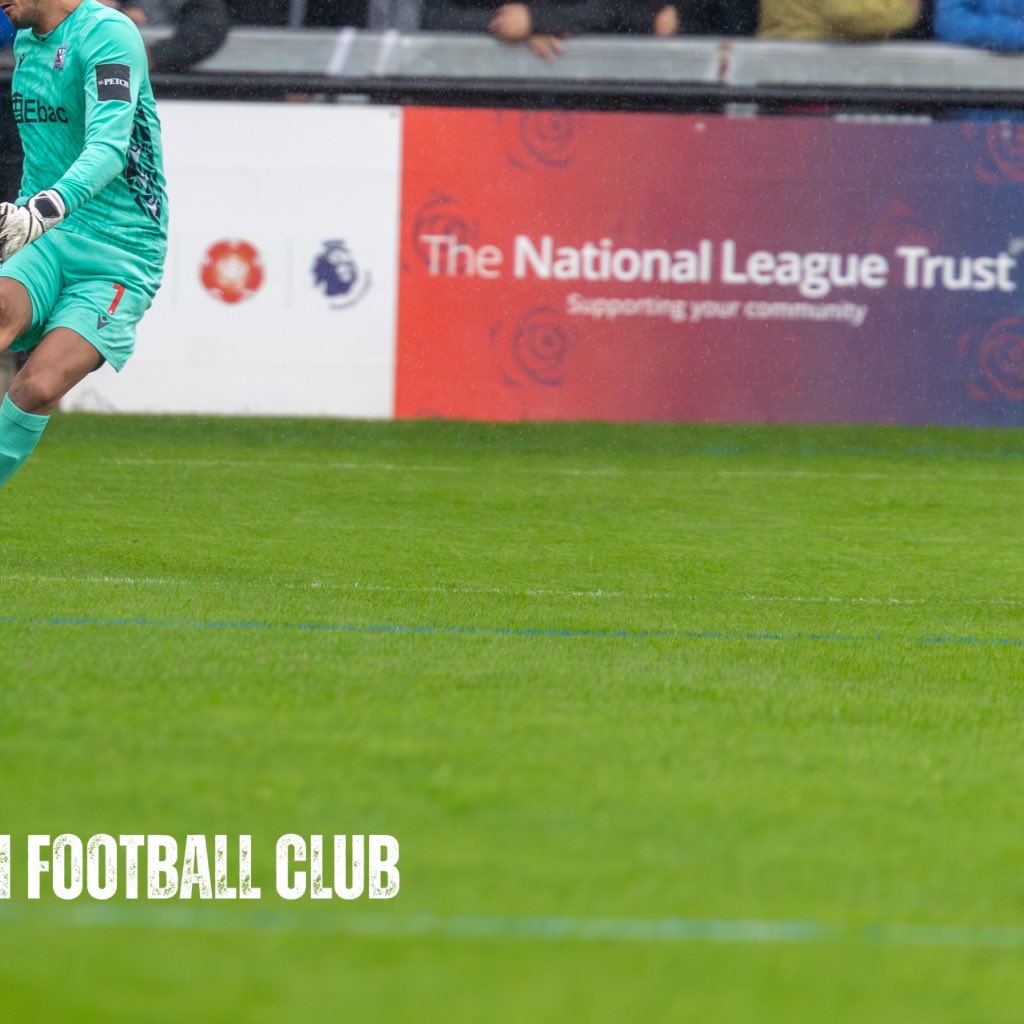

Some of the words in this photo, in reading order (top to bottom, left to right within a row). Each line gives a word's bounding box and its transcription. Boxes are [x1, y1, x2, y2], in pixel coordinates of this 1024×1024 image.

[24, 98, 69, 123] Ebac
[419, 234, 503, 278] The
[514, 235, 713, 284] National
[721, 239, 890, 299] League
[895, 245, 1017, 292] Trust
[106, 282, 126, 316] 1
[565, 293, 688, 323] Supporting
[688, 300, 742, 323] your
[742, 300, 868, 326] community
